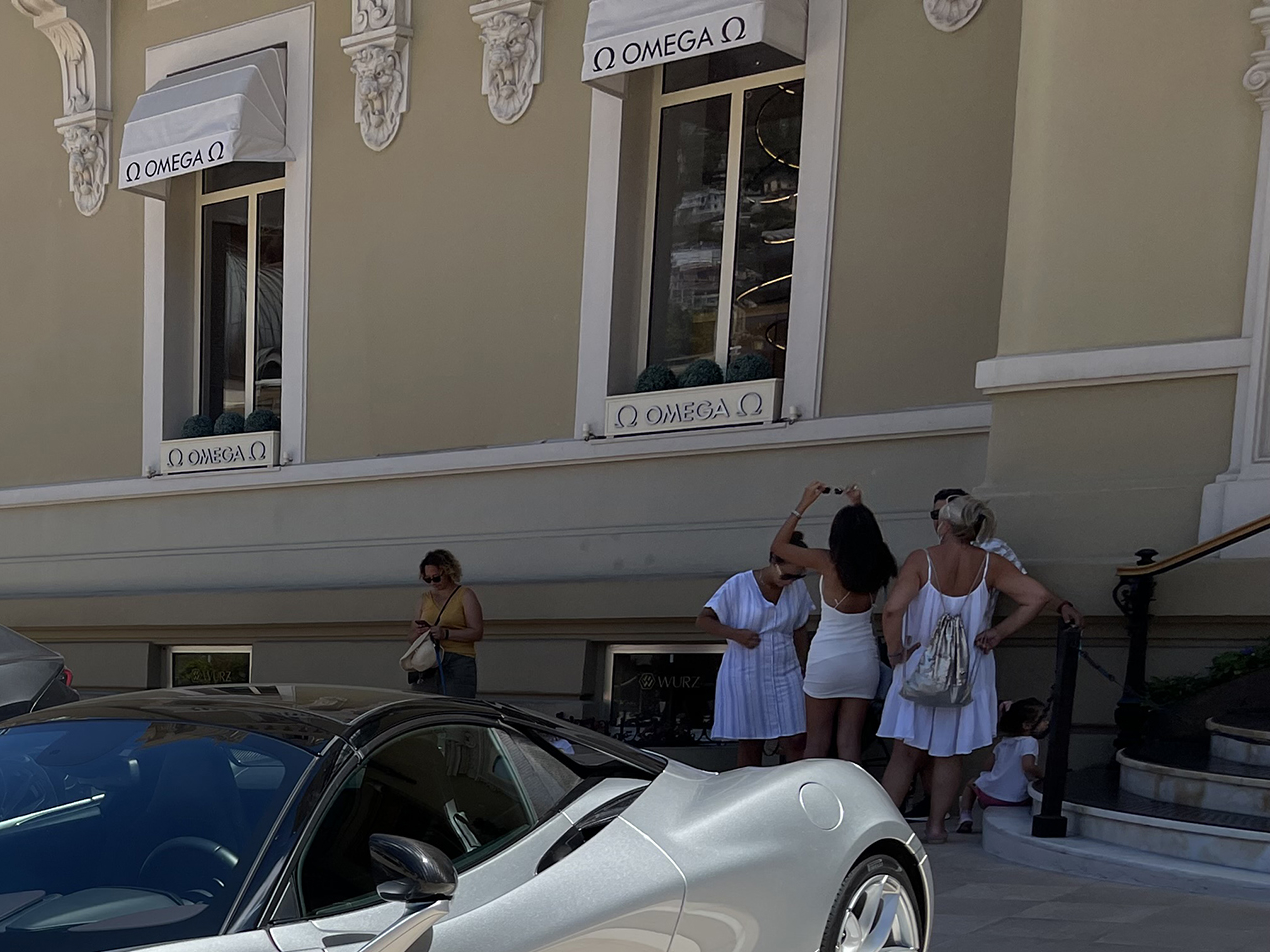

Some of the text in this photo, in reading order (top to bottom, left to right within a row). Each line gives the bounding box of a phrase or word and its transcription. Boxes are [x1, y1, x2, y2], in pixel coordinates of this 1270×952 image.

[622, 26, 714, 65] OMEGA
[144, 148, 204, 177] OMEGA
[646, 398, 730, 426] OMEGA
[188, 445, 246, 466] OMEGA
[658, 676, 700, 688] WURZ
